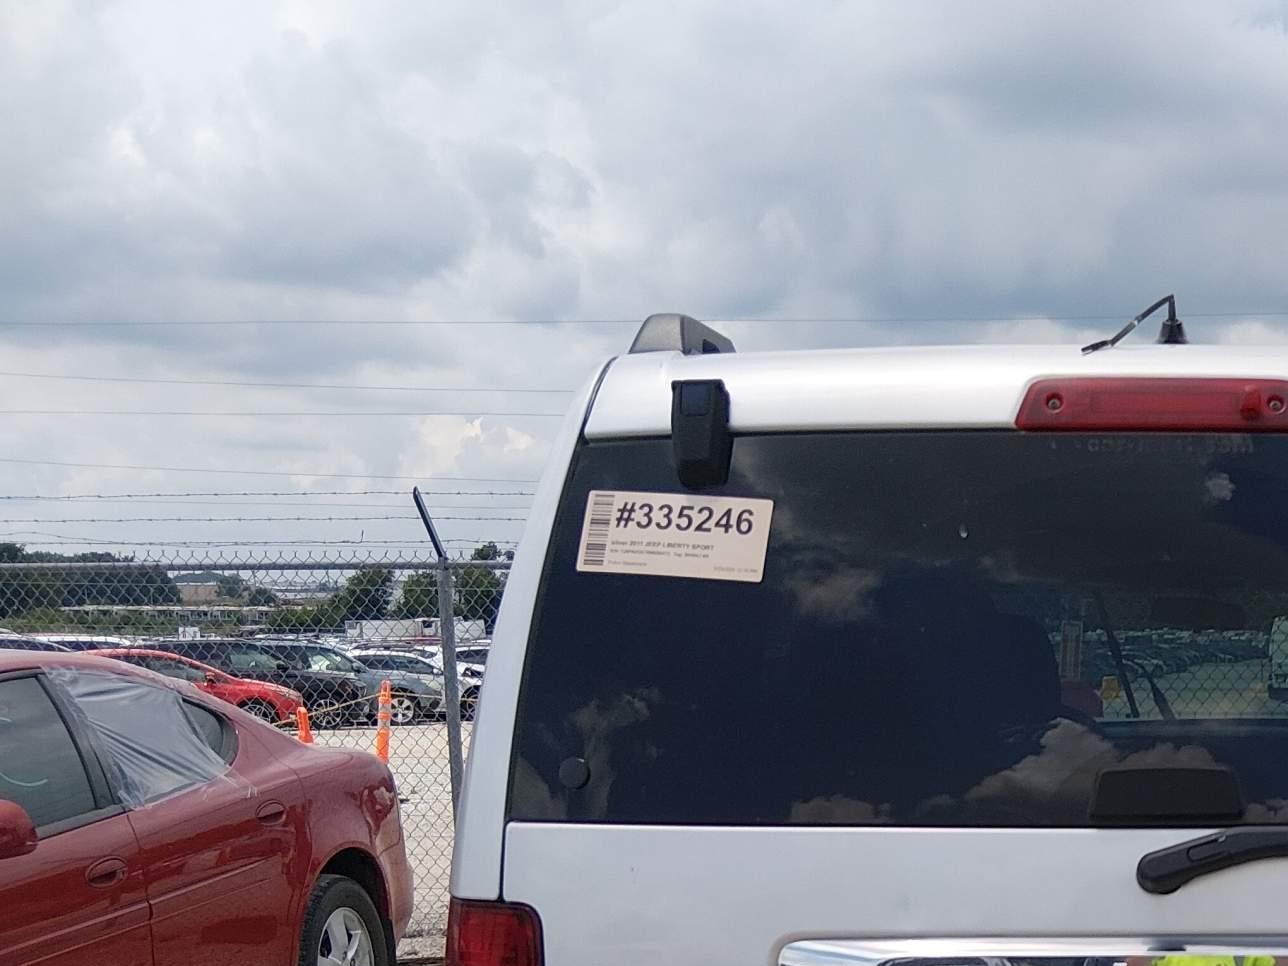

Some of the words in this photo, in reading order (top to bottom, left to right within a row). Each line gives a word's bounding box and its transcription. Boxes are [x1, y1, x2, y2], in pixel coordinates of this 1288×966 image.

[615, 501, 755, 535] #335246
[662, 541, 690, 549] LIBERTY
[691, 543, 715, 551] SPORT
